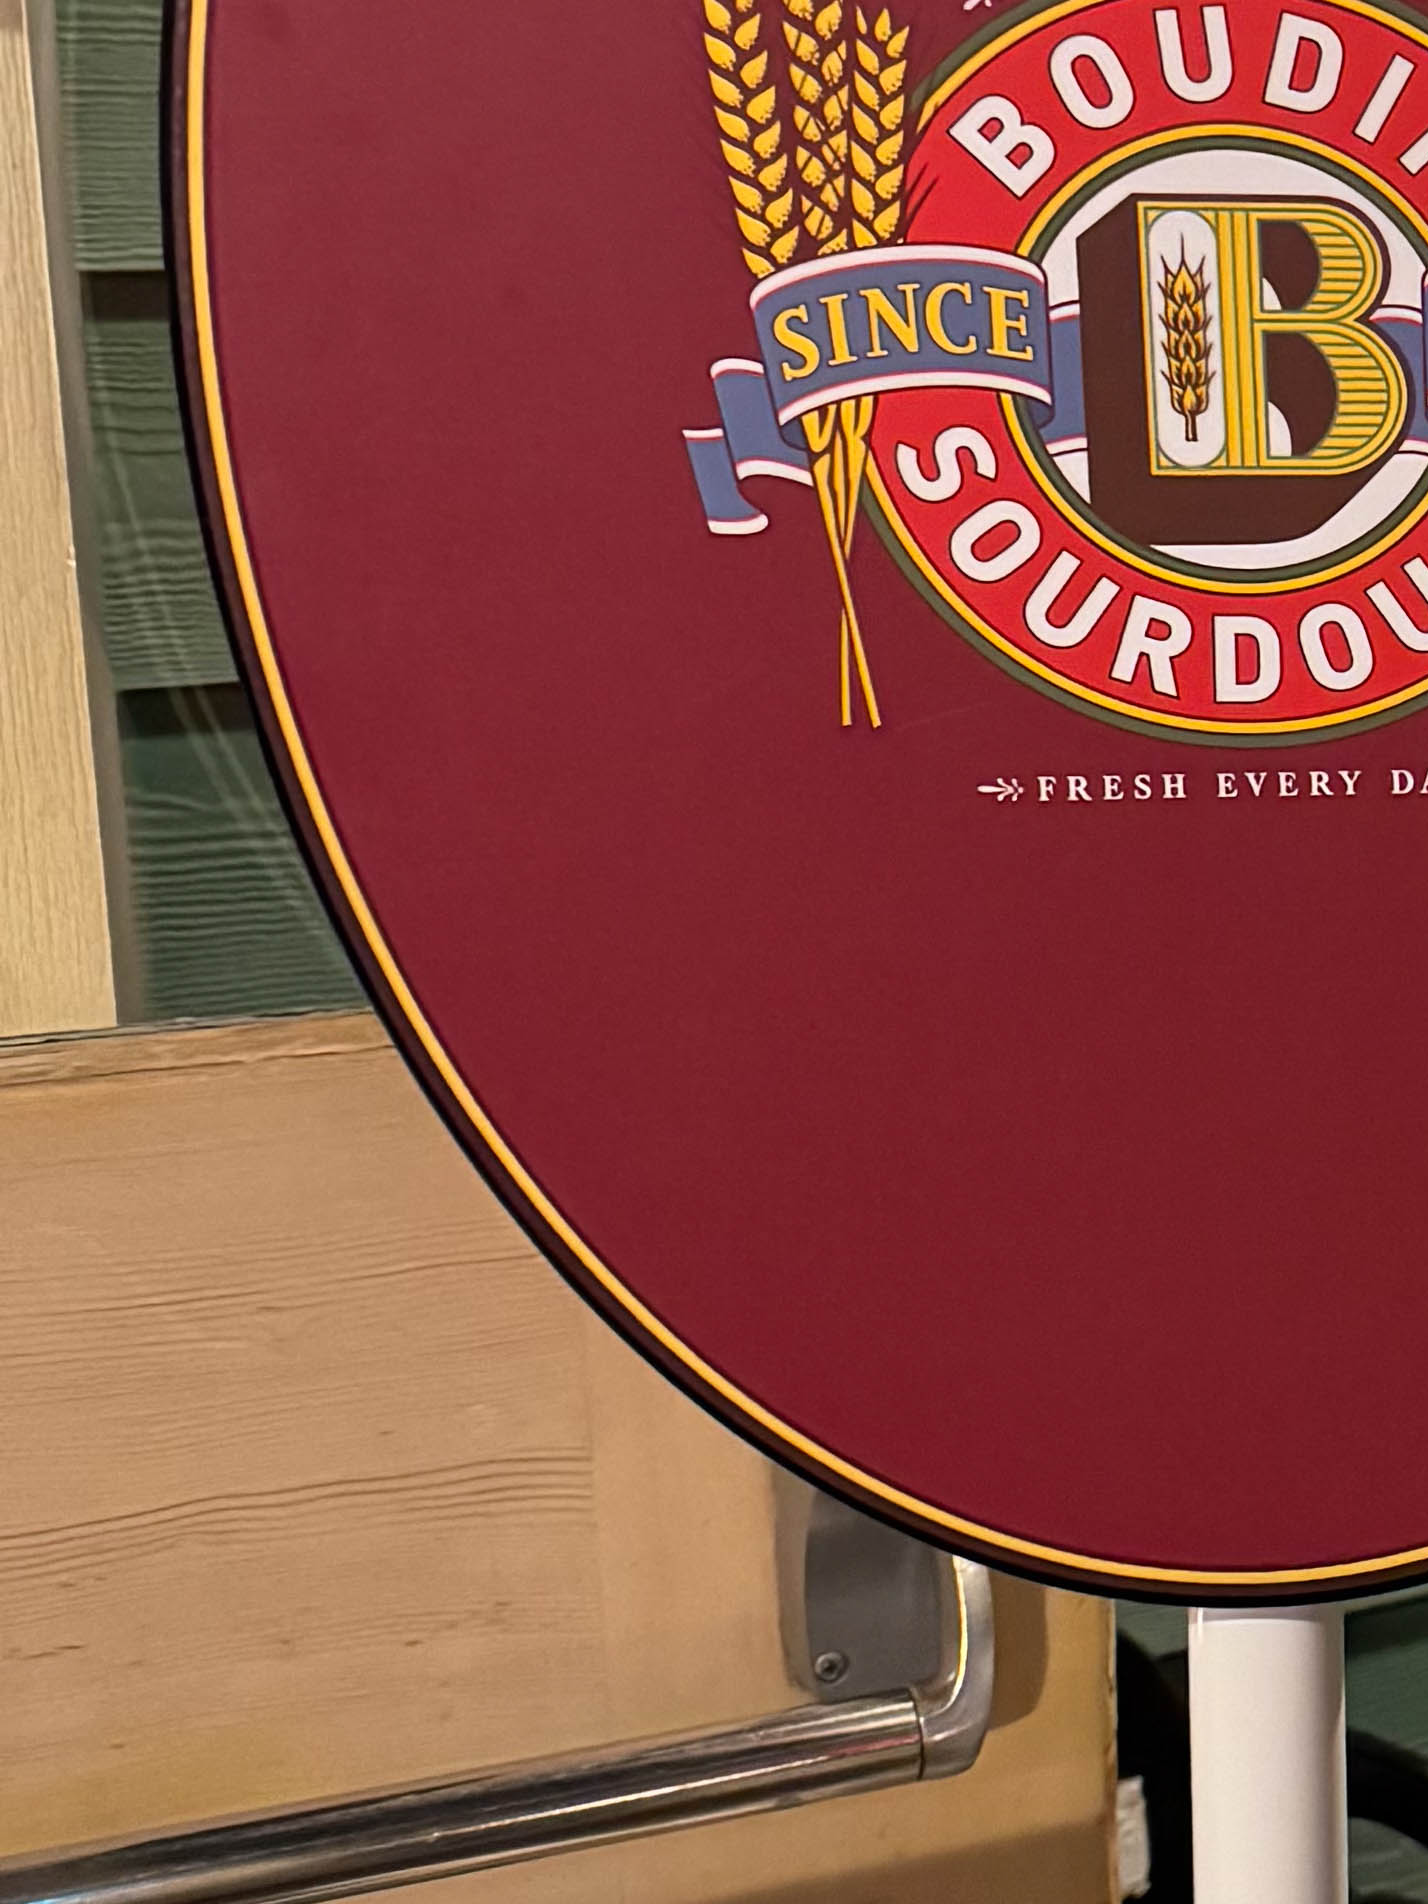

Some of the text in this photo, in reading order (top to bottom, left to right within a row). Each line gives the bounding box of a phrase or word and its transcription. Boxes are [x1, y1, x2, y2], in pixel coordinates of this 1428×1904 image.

[768, 280, 1037, 384] SINCE
[1036, 772, 1188, 803] FRESH
[1216, 769, 1362, 799] EVERY
